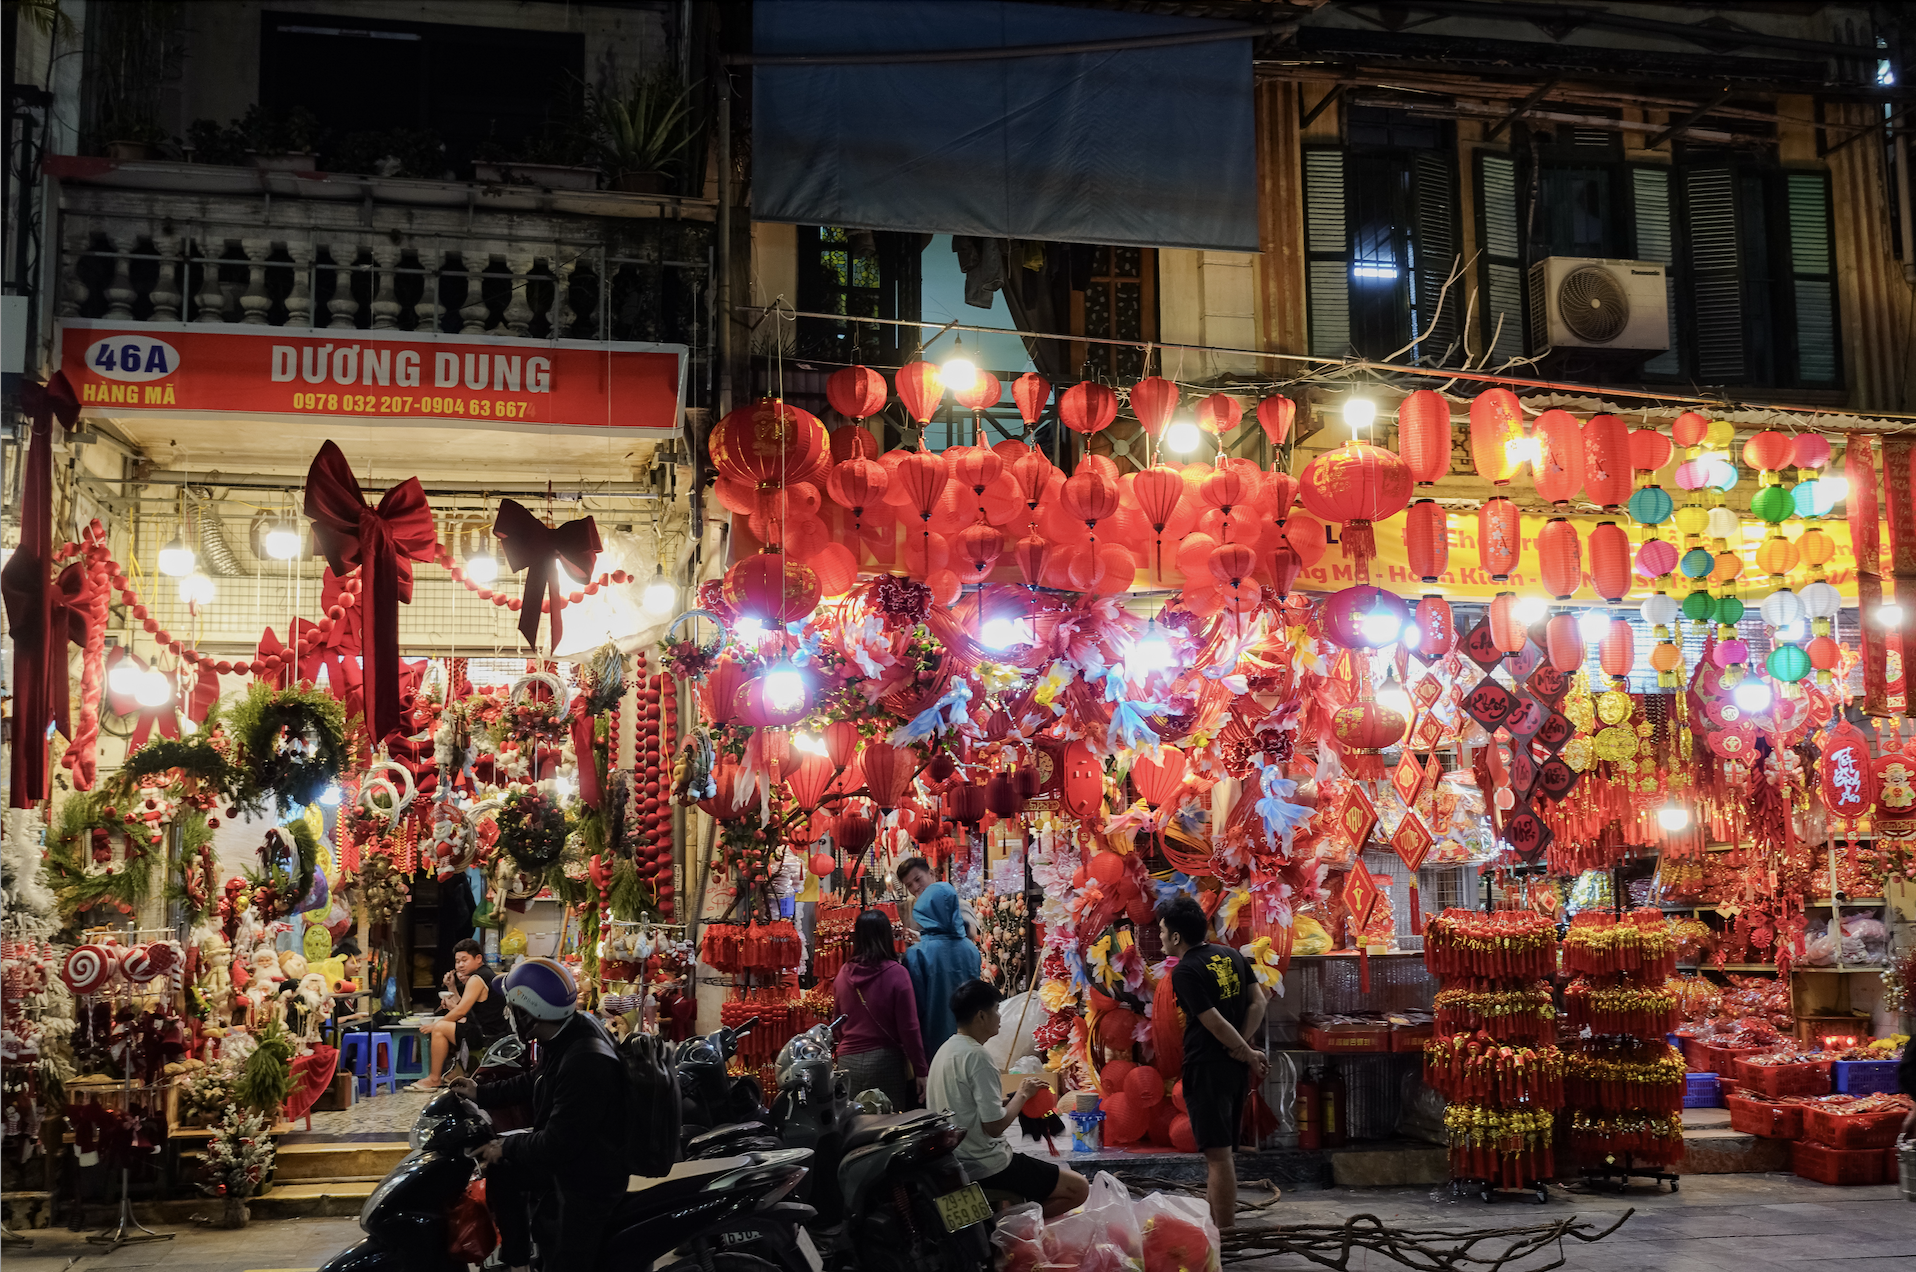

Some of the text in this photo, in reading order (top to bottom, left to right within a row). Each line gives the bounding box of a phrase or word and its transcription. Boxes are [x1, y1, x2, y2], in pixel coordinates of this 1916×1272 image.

[95, 343, 168, 373] 46A
[271, 343, 550, 393] DƯƠNG DUNG
[83, 381, 176, 405] HÀNG MÃ
[293, 392, 338, 411] 0978
[342, 394, 376, 412] 032
[380, 396, 465, 414] 207-0904
[469, 399, 491, 417] 63
